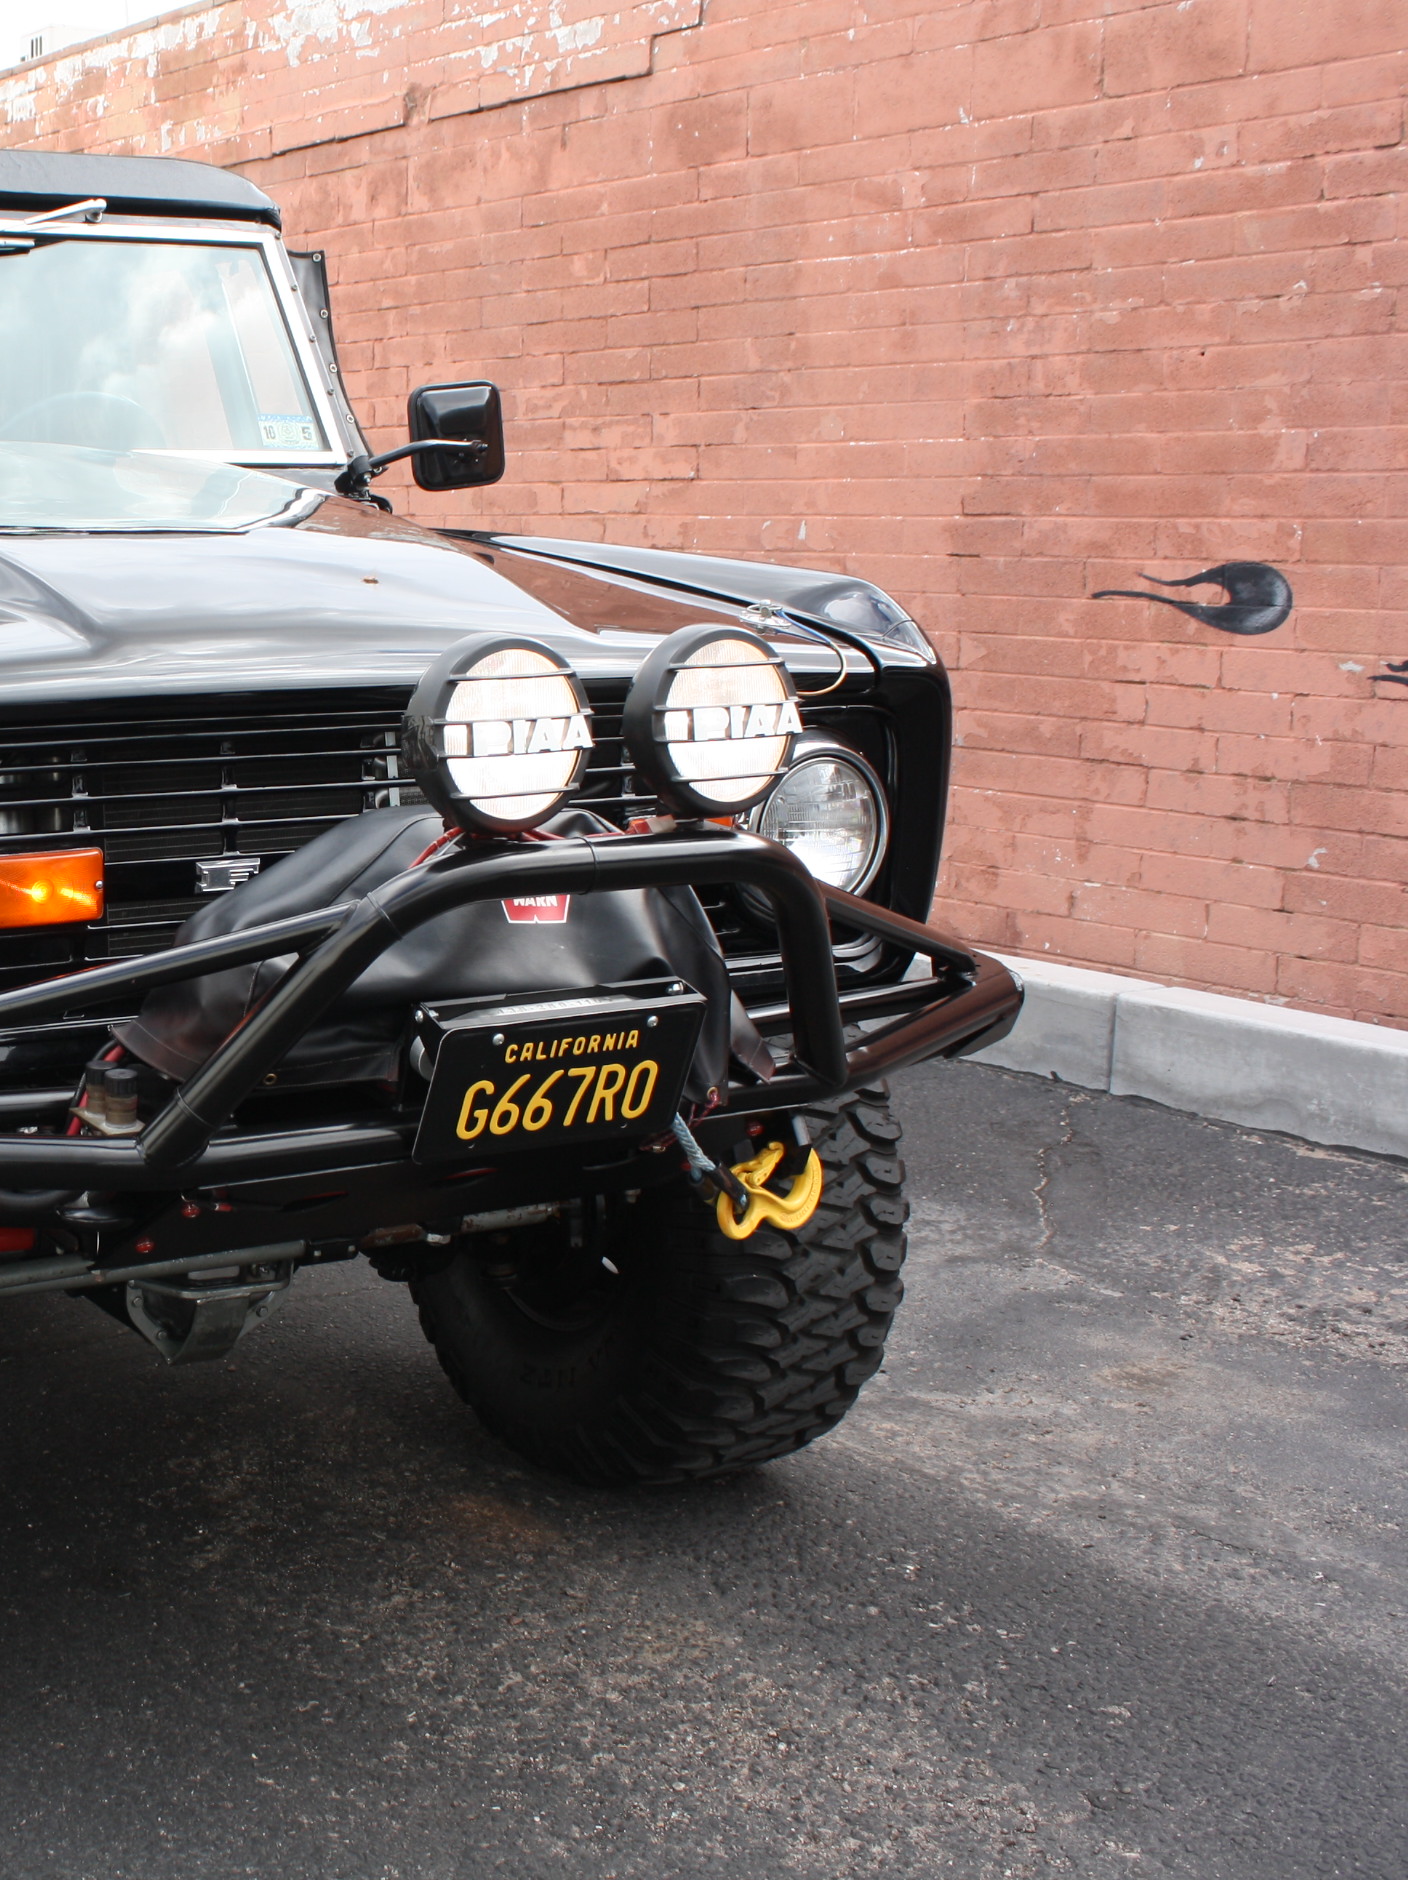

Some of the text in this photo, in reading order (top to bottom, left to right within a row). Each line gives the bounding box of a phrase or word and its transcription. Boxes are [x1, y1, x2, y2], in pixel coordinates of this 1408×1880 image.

[472, 714, 593, 757] PIAA
[693, 702, 804, 741] PIAA
[504, 1030, 640, 1064] CALIFORNIA
